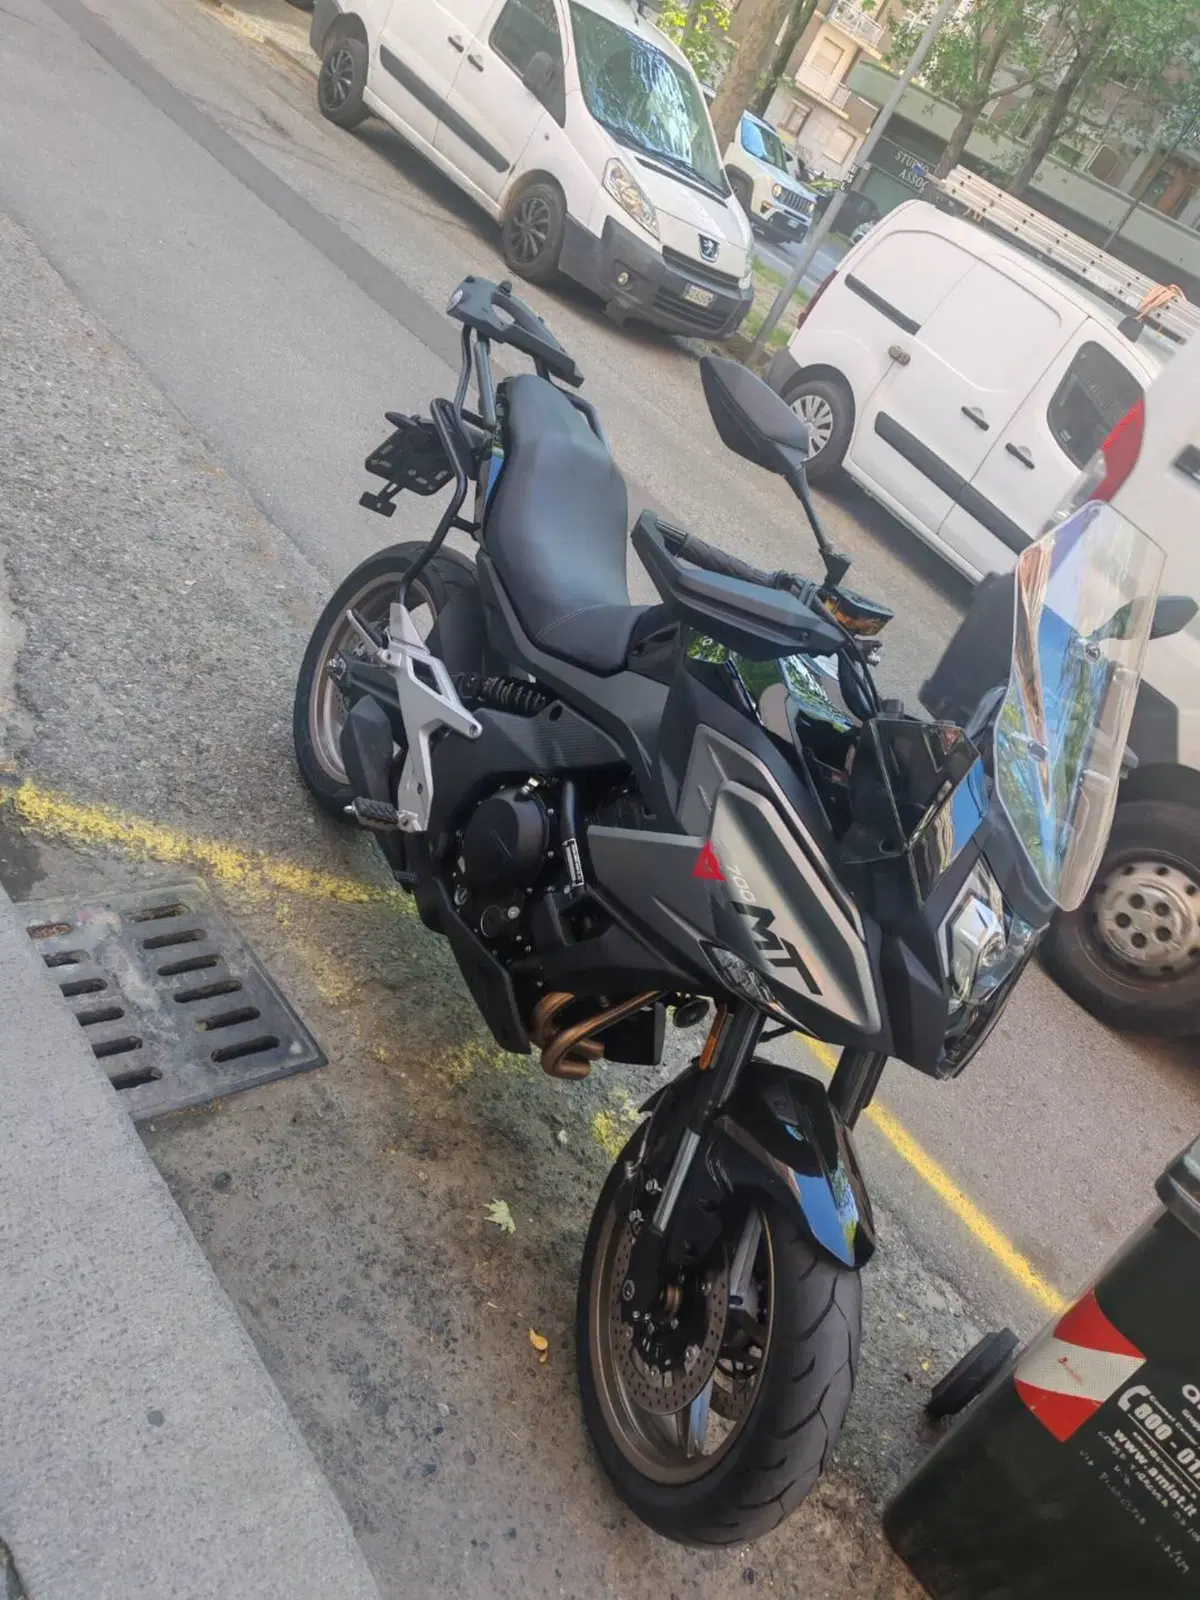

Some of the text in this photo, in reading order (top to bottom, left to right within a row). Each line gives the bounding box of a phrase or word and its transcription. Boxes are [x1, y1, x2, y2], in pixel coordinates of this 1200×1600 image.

[726, 864, 757, 902] 700
[731, 900, 823, 996] MT
[1134, 1403, 1173, 1440] 800
[1113, 1429, 1197, 1517] www.amiat.it
